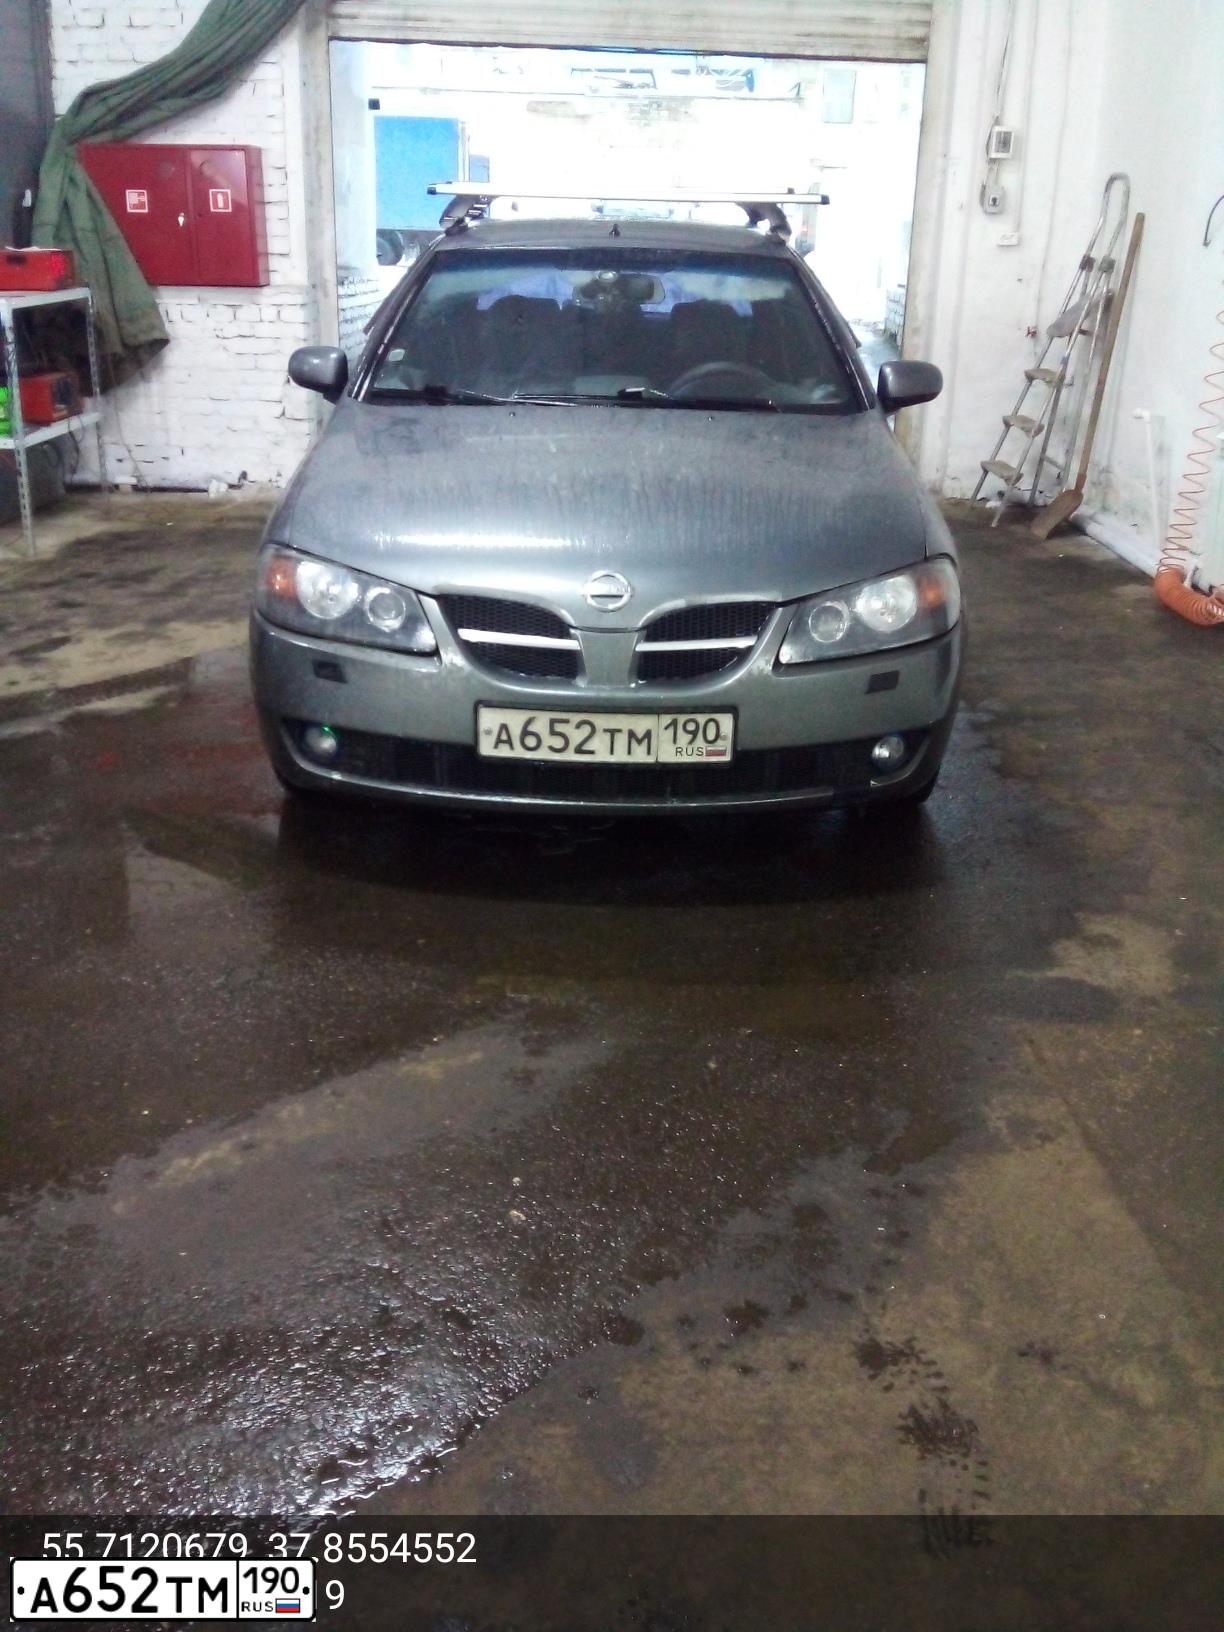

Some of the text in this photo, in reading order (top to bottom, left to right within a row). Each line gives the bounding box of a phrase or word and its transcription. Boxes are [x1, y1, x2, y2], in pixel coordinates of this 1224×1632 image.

[493, 716, 721, 756] А652ТМ 190
[675, 746, 704, 757] RUS
